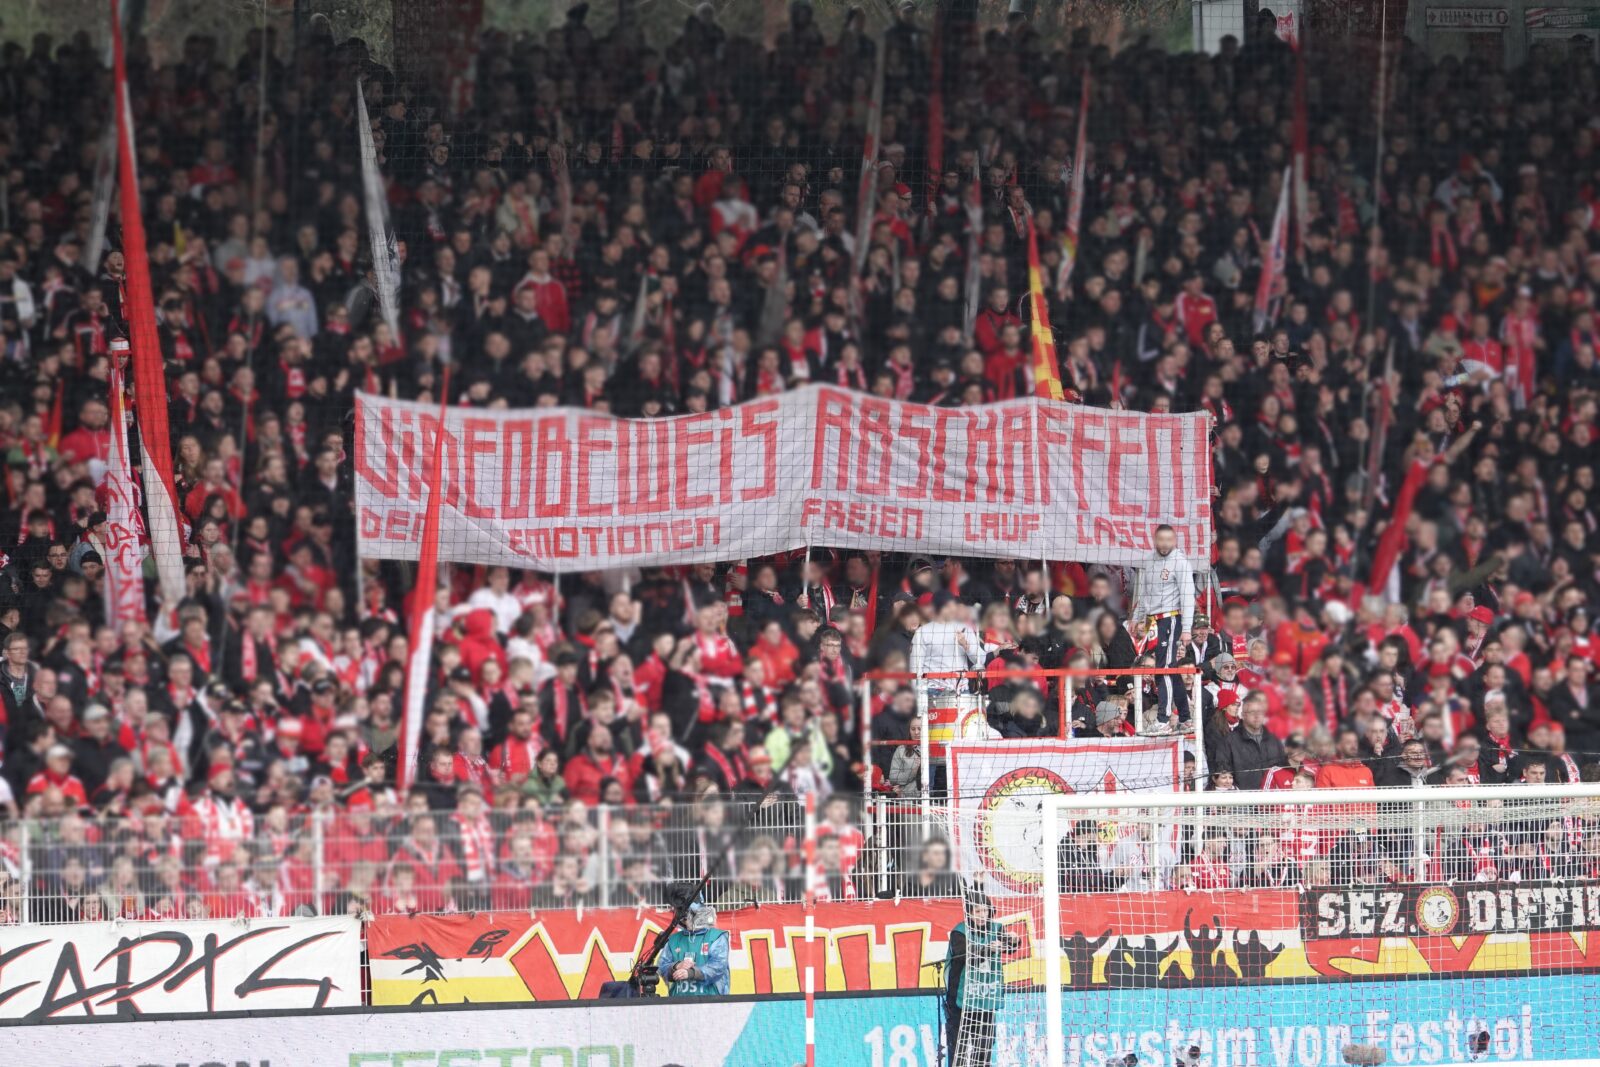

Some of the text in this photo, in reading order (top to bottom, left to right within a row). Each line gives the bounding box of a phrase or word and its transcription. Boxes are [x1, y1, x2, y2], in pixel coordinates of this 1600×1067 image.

[811, 388, 1210, 518] ABSCHAFFEN!
[509, 515, 721, 559] EMOTIONEN
[964, 512, 1040, 542] LAUF
[1318, 892, 1417, 936] SEZ.
[1269, 1024, 1351, 1066] von
[1366, 1004, 1534, 1065] Festool
